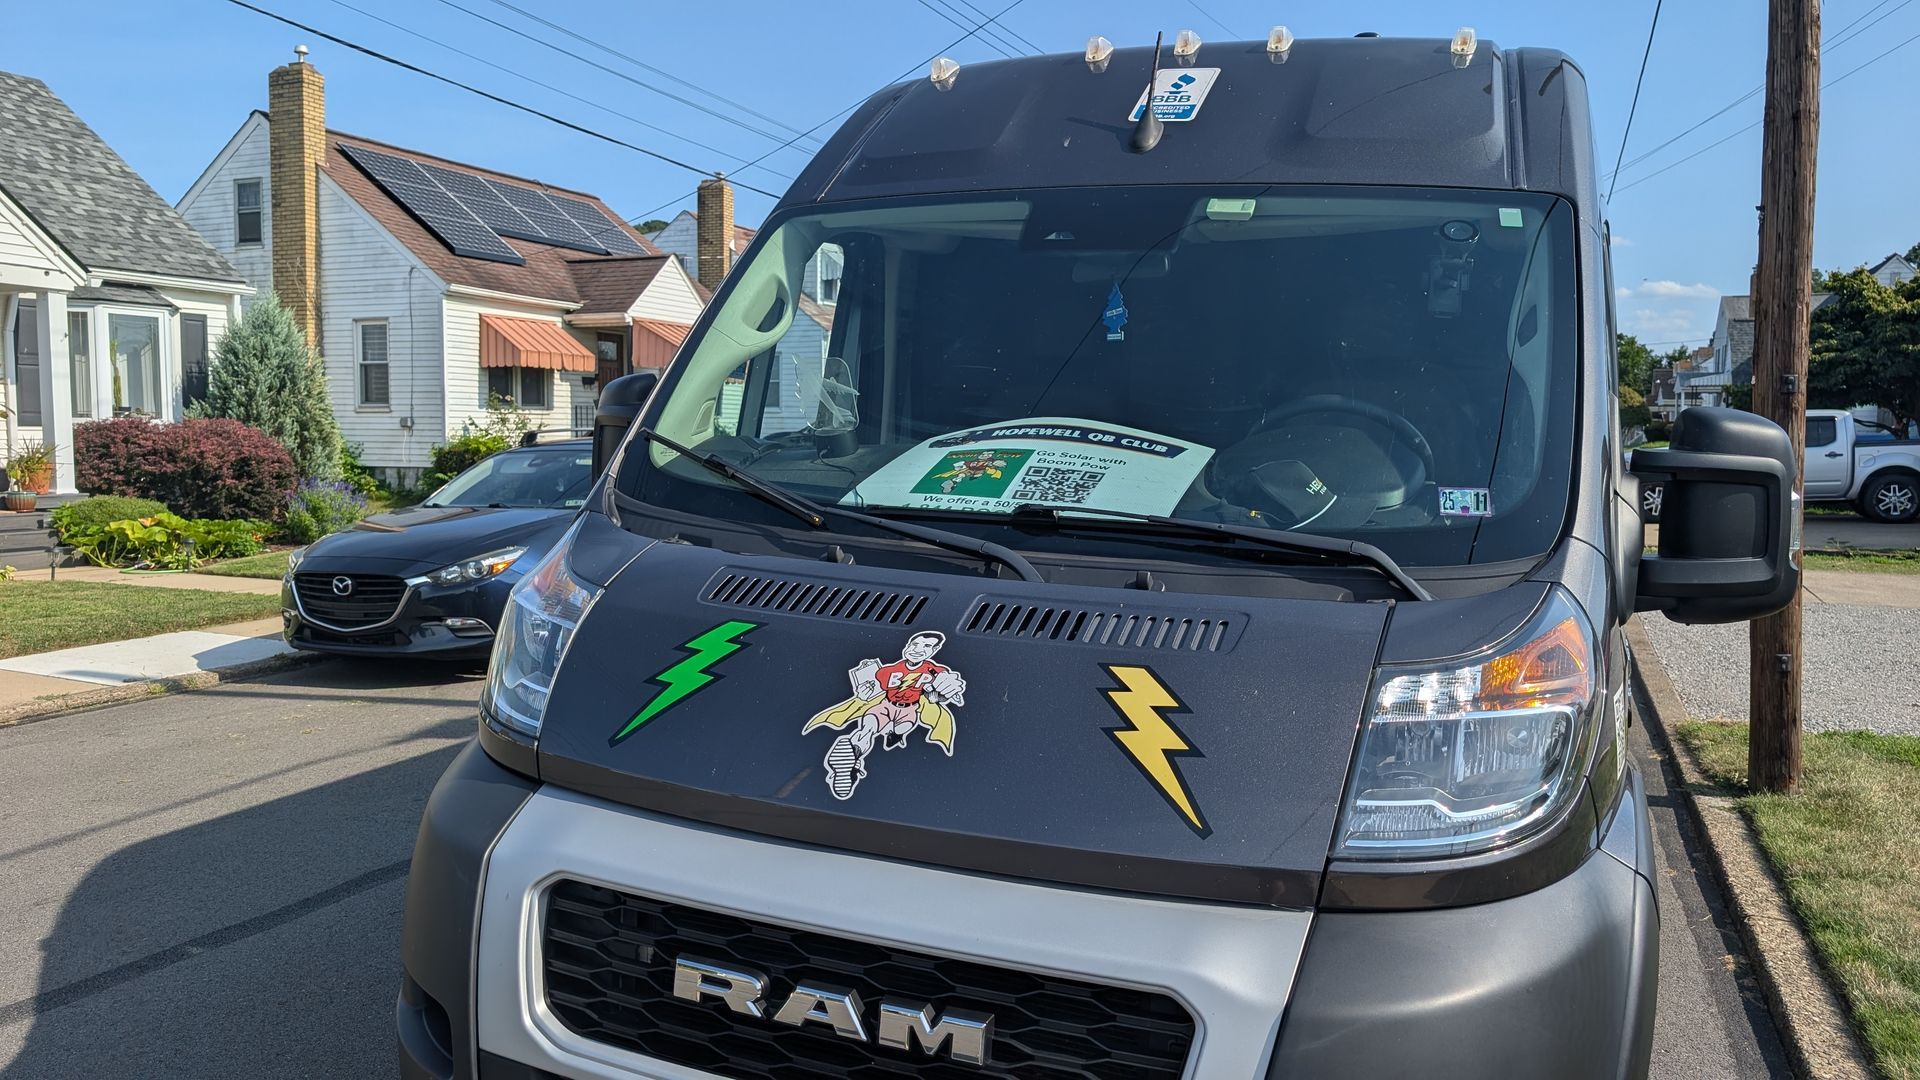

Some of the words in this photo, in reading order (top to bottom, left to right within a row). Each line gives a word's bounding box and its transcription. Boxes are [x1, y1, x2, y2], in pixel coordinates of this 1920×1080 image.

[1152, 95, 1191, 103] BBB
[992, 428, 1081, 438] HOPEWELL
[1087, 432, 1116, 443] QB
[1120, 438, 1168, 453] CLUB
[1036, 457, 1077, 467] Boom
[1080, 461, 1111, 470] Pow
[1059, 451, 1095, 461] Solar
[1098, 457, 1127, 466] with
[923, 495, 943, 503] We
[946, 497, 979, 506] offer
[993, 500, 1024, 509] 50/5
[1441, 491, 1455, 510] 25
[1473, 492, 1488, 512] 11
[673, 954, 993, 1066] RAM
